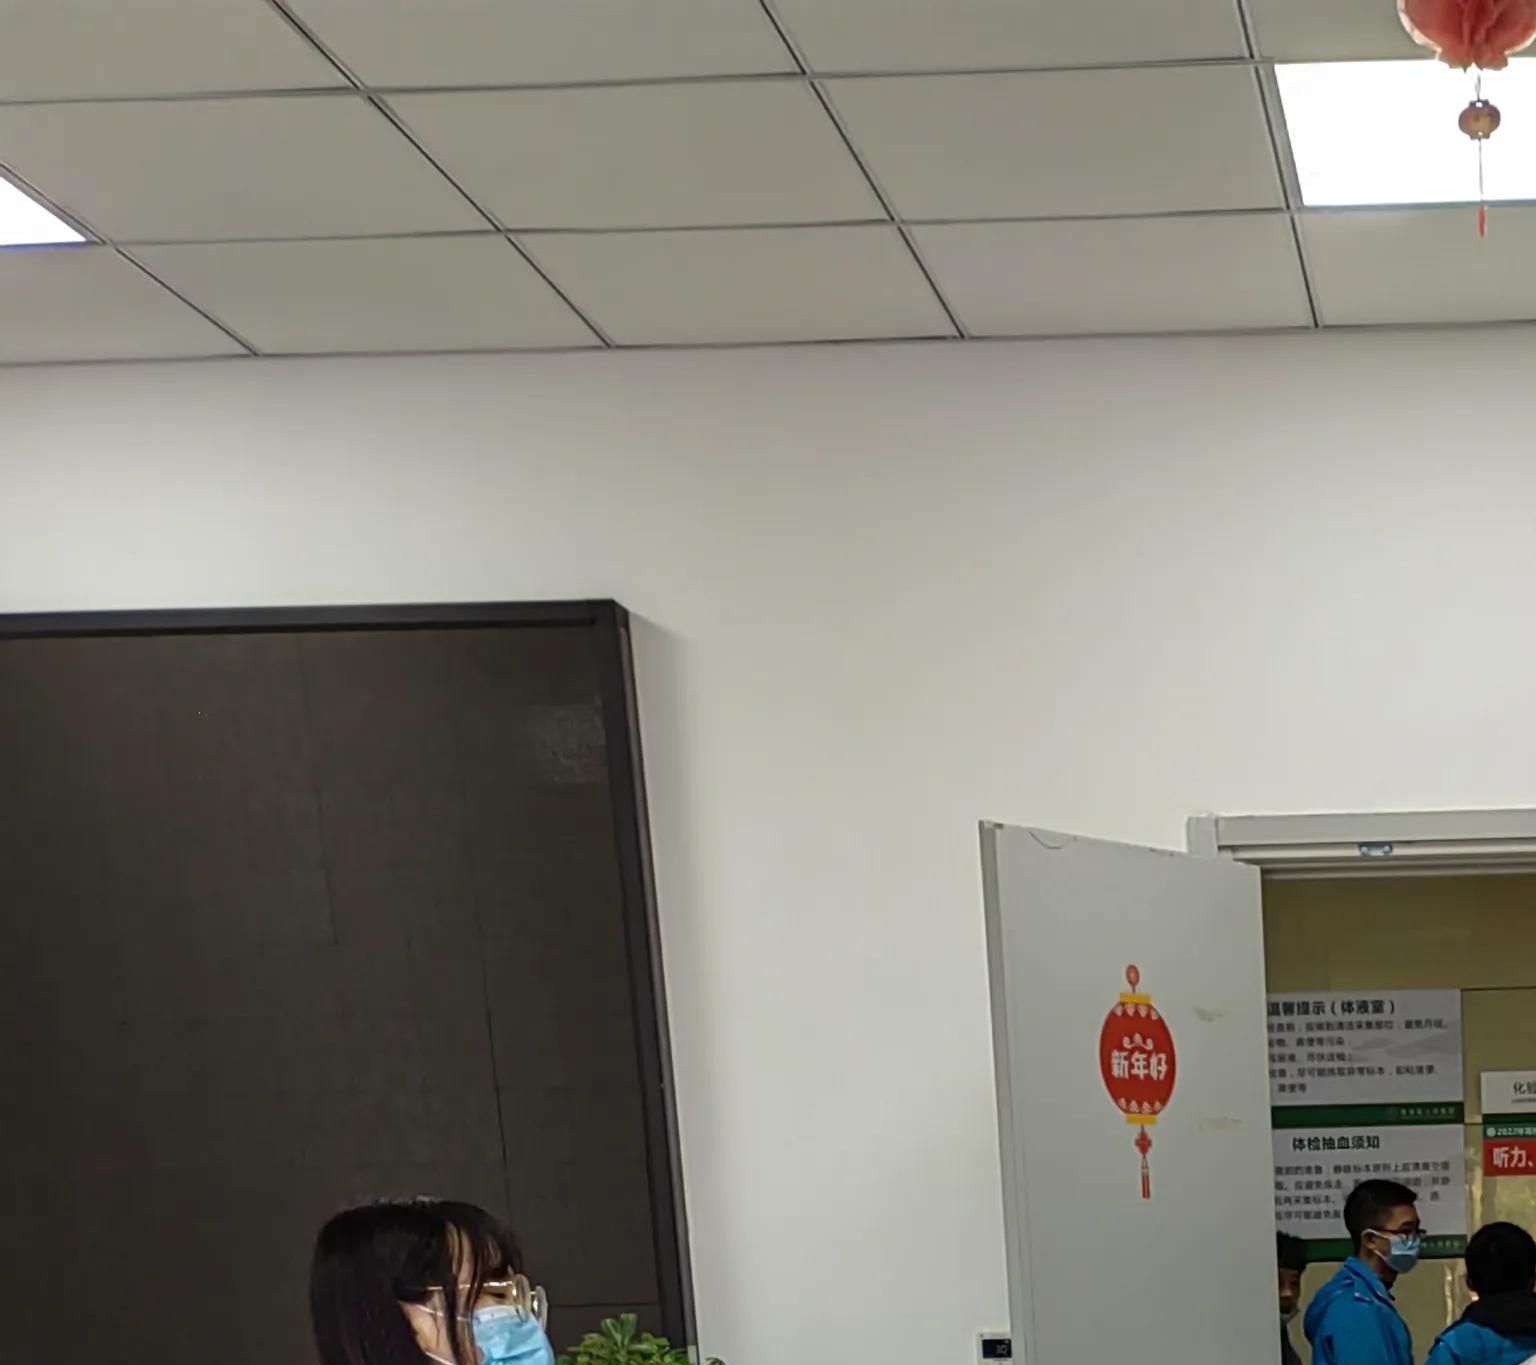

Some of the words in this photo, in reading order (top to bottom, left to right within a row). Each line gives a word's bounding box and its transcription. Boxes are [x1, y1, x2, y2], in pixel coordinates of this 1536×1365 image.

[1111, 1050, 1168, 1081] 新年好
[1292, 1135, 1381, 1151] 体检抽血须知
